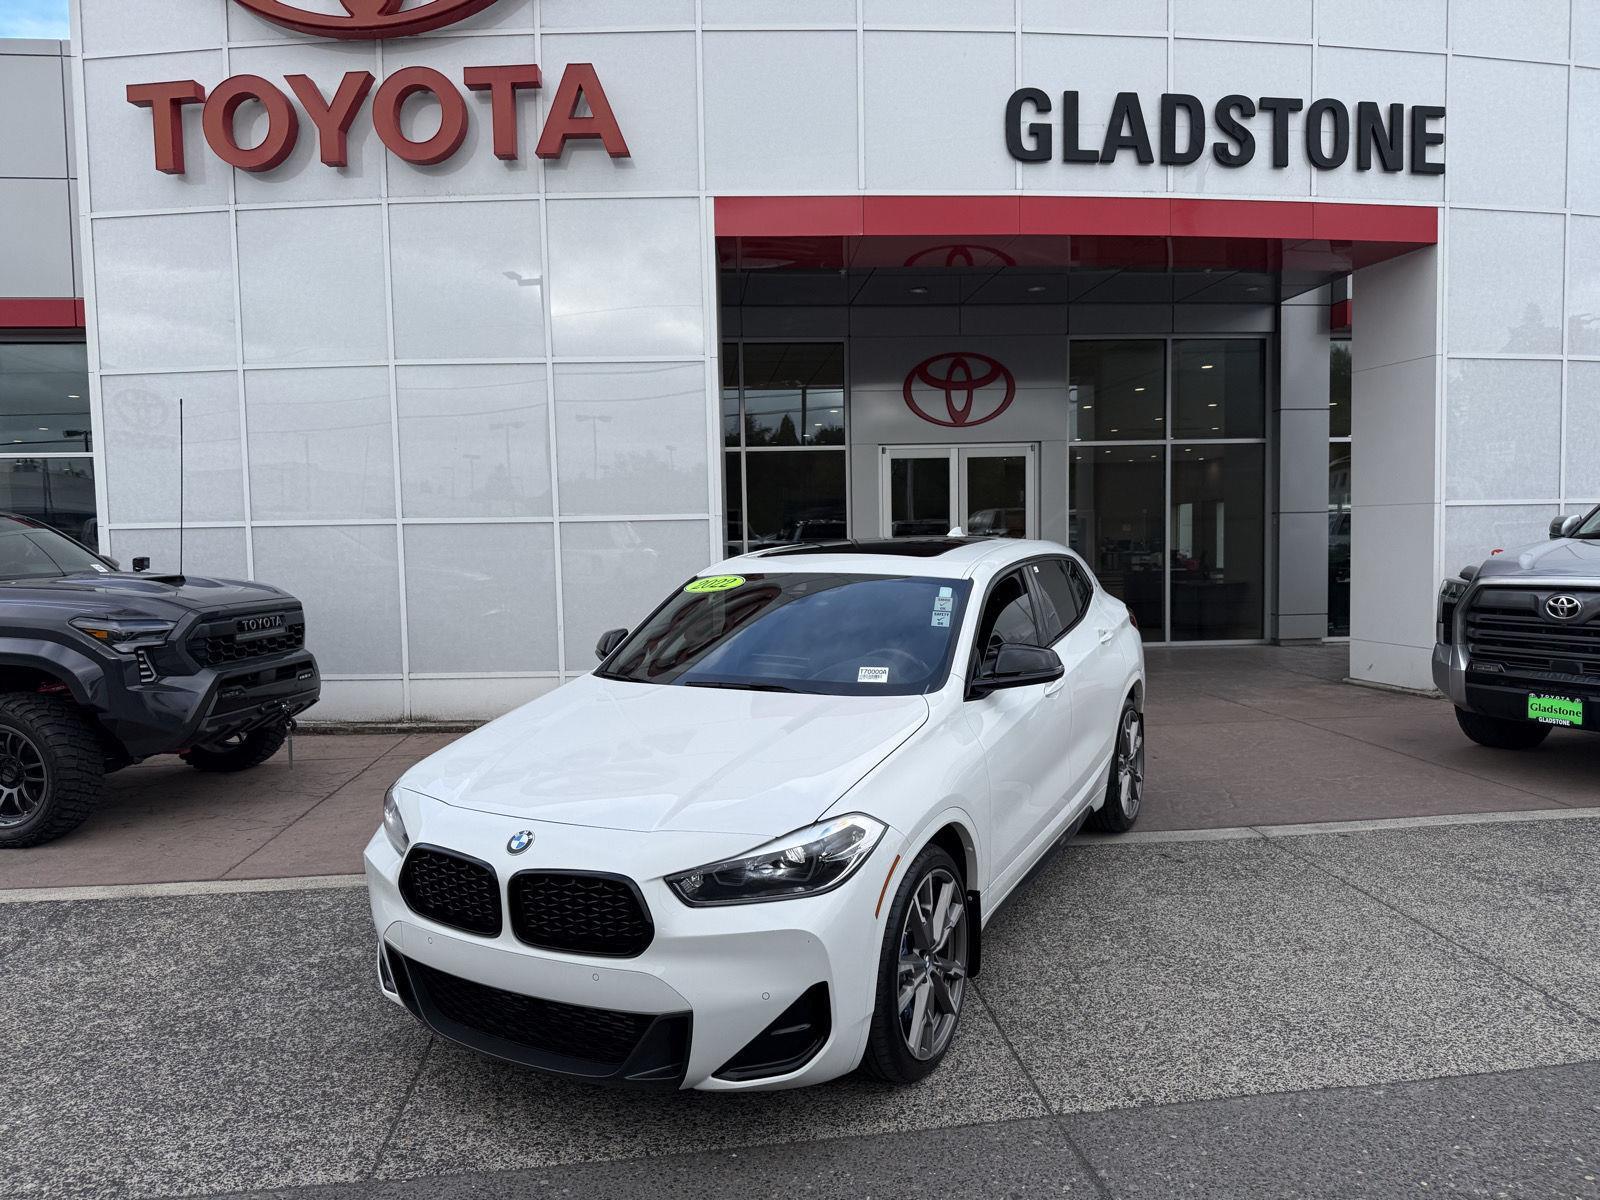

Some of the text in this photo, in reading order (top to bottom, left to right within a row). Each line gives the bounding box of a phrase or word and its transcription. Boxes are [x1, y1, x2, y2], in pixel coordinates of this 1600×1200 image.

[126, 63, 631, 174] TOYOTA
[1005, 87, 1445, 175] GLADSTONE
[692, 578, 737, 590] 2022
[242, 616, 282, 631] TOYOTA
[1540, 693, 1570, 701] TOYOTA
[1530, 702, 1582, 718] Gladstone
[1538, 716, 1571, 726] GLADSTONE
